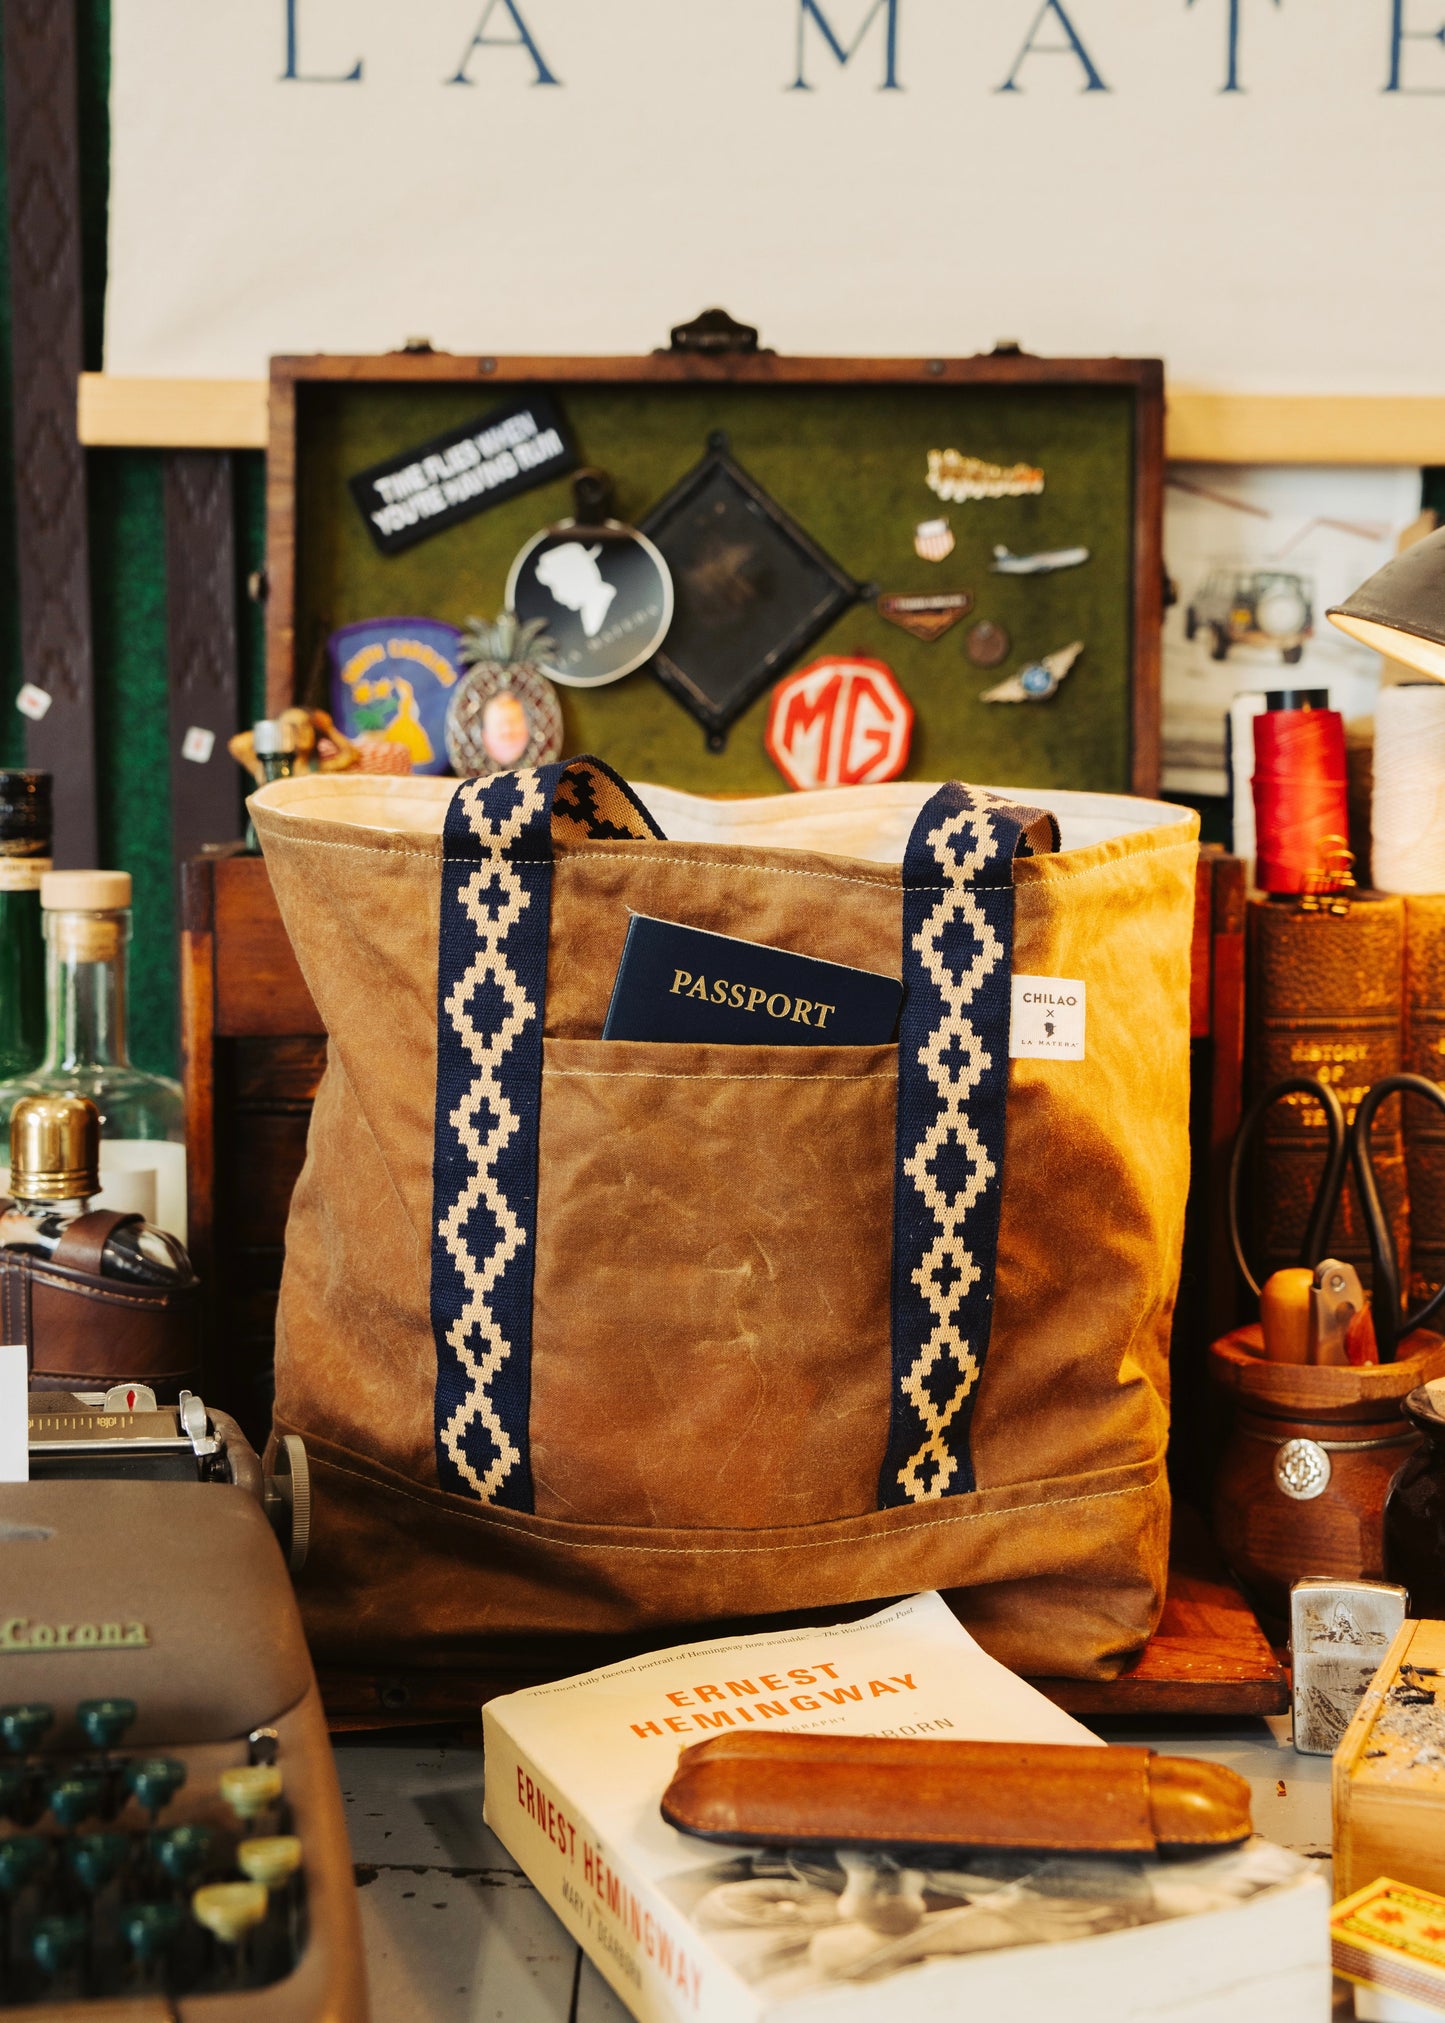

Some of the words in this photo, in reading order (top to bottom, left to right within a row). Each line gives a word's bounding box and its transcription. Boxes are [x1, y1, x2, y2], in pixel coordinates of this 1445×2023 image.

[277, 0, 562, 87] LA
[783, 675, 895, 784] MG
[669, 969, 836, 1029] PASSPORT
[1022, 992, 1077, 1006] CHILAO
[0, 1617, 147, 1648] Corona
[578, 1676, 600, 1688] fully
[601, 1666, 636, 1681] faceted
[637, 1656, 675, 1672] portrait
[676, 1651, 687, 1661] of
[688, 1643, 743, 1659] Hemingway
[744, 1641, 765, 1650] now
[894, 1607, 914, 1621] Post
[629, 1673, 919, 1739] HEMINGWAY
[665, 1662, 841, 1708] ERNEST
[862, 1718, 955, 1738] BORN
[517, 1765, 576, 1864] ERNEST
[583, 1840, 702, 2011] HEMINGWAY
